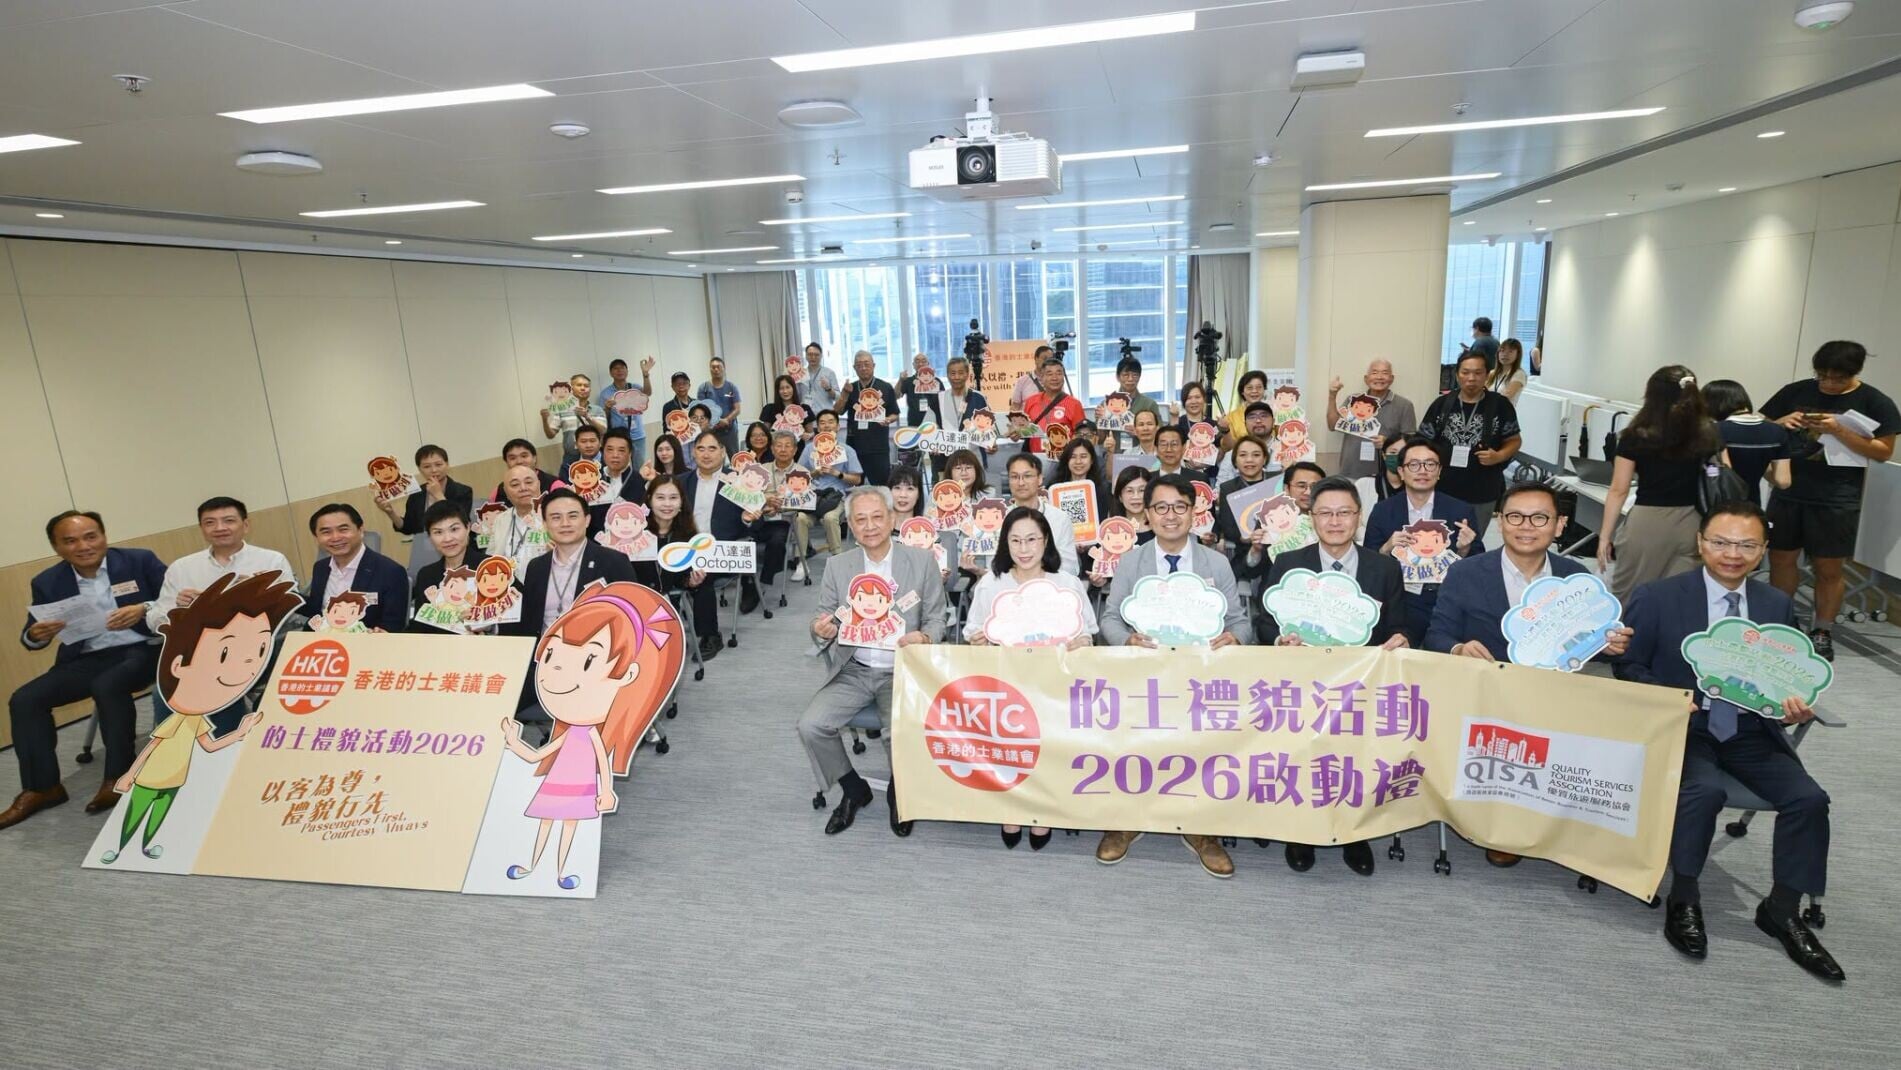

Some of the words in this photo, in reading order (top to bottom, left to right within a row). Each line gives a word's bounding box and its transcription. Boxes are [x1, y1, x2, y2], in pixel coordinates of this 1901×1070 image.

[713, 545, 752, 557] 八達通
[696, 557, 753, 571] Octopus
[291, 648, 346, 677] HKTC
[280, 683, 340, 693] 香港的士業議會
[354, 670, 507, 695] 香港的士業議會
[940, 691, 1026, 738] HKTC
[1069, 678, 1430, 742] 的士禮貌活動
[261, 725, 486, 758] 的士禮貌活動2026
[932, 741, 1034, 763] 香港的士業議會
[1463, 757, 1540, 791] QTSA
[1551, 763, 1591, 777] QUALITY
[1548, 779, 1613, 798] ASSOCIATION
[1550, 771, 1592, 786] TOURISM
[1594, 779, 1634, 793] SERVICES
[281, 791, 390, 827] 禮貌行先
[1547, 786, 1631, 812] 優質旅遊服務協會
[301, 816, 370, 834] Passengers
